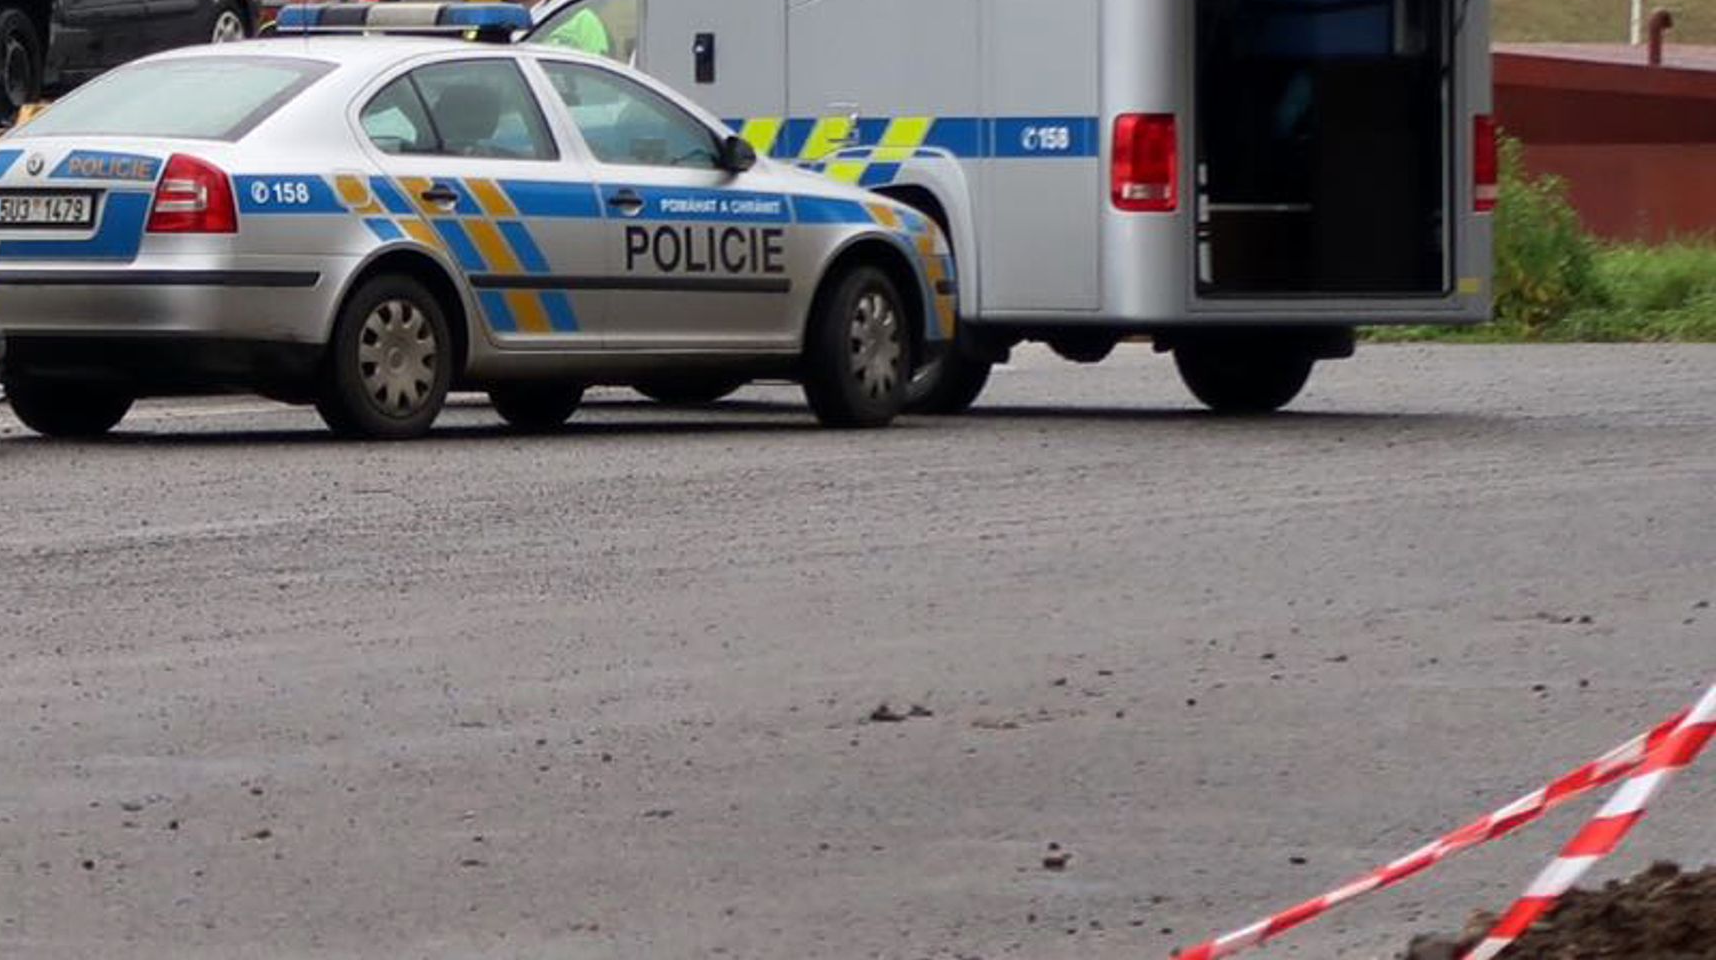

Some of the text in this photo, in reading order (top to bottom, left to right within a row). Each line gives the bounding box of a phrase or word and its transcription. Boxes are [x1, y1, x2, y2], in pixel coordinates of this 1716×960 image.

[1038, 127, 1070, 150] 158
[68, 157, 152, 178] POLICIE
[273, 182, 309, 204] 158
[0, 198, 84, 220] 5U3 1479
[626, 225, 784, 273] POLICIE
